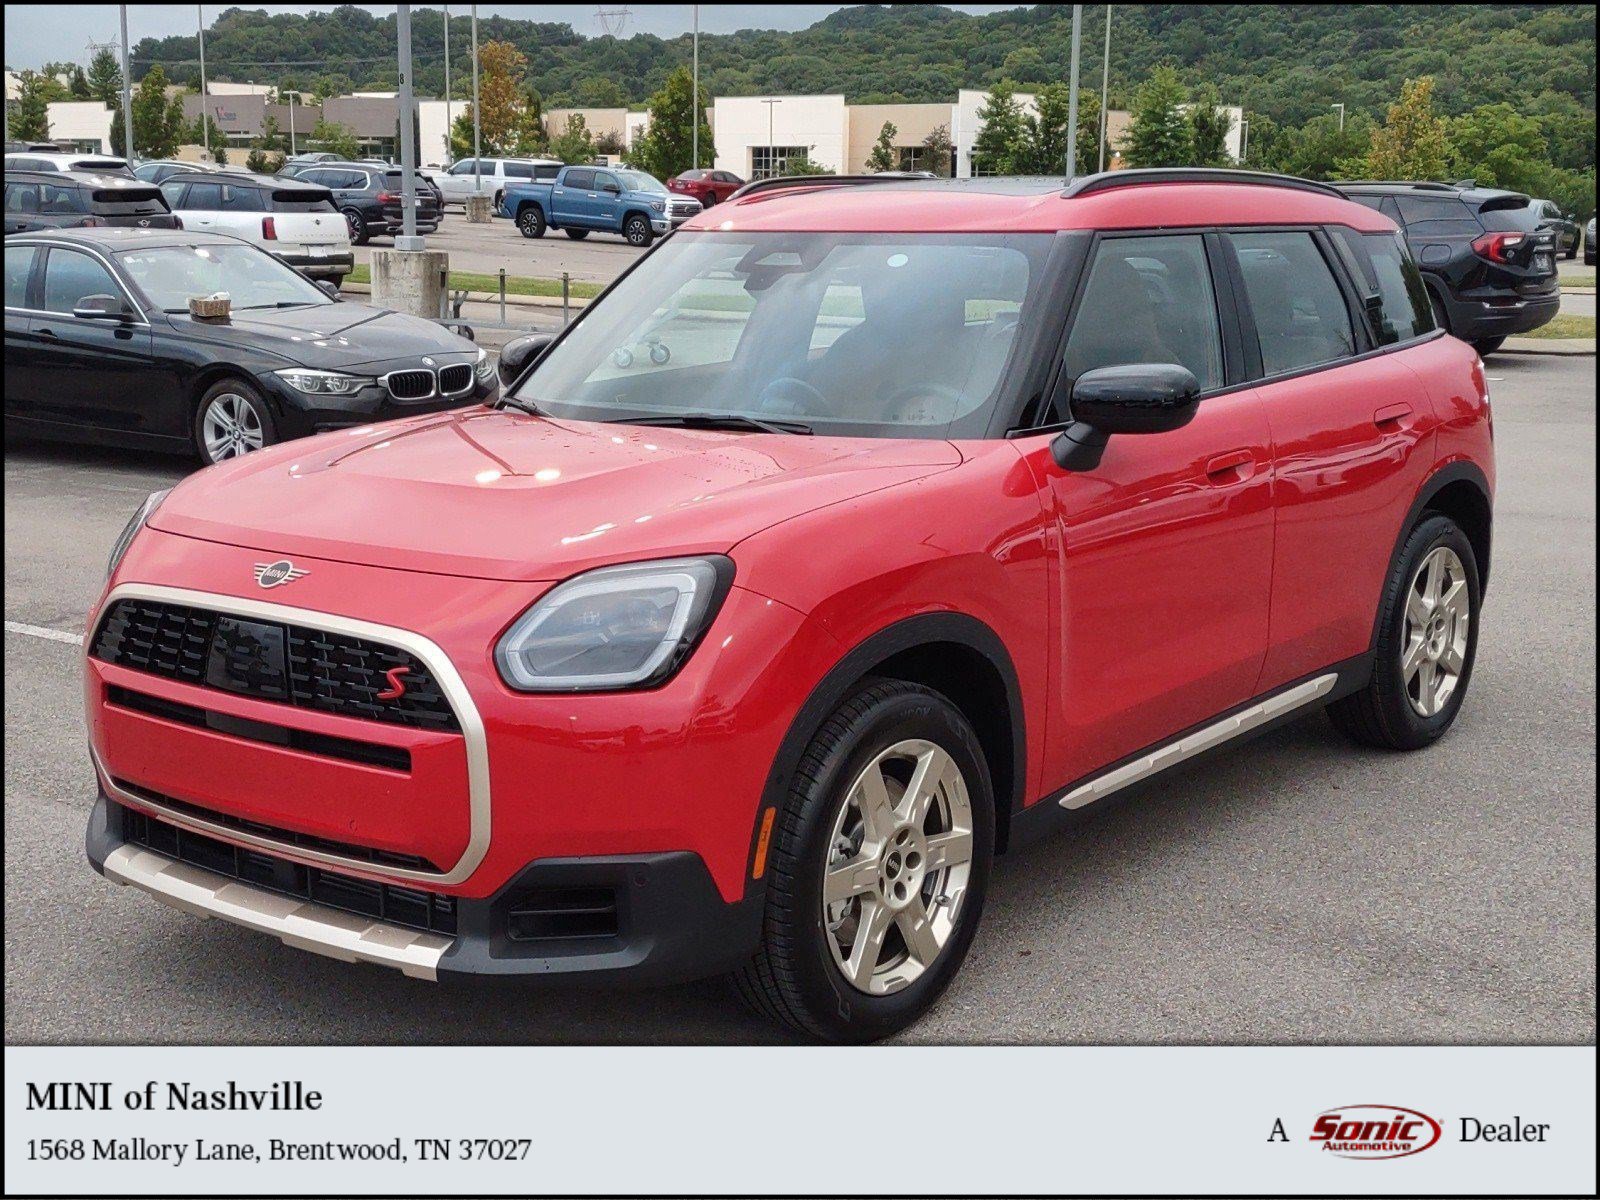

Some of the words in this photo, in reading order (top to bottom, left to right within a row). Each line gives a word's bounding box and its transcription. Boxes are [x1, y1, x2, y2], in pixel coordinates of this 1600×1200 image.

[400, 72, 405, 85] 8
[265, 567, 286, 579] MINI
[376, 666, 411, 700] S
